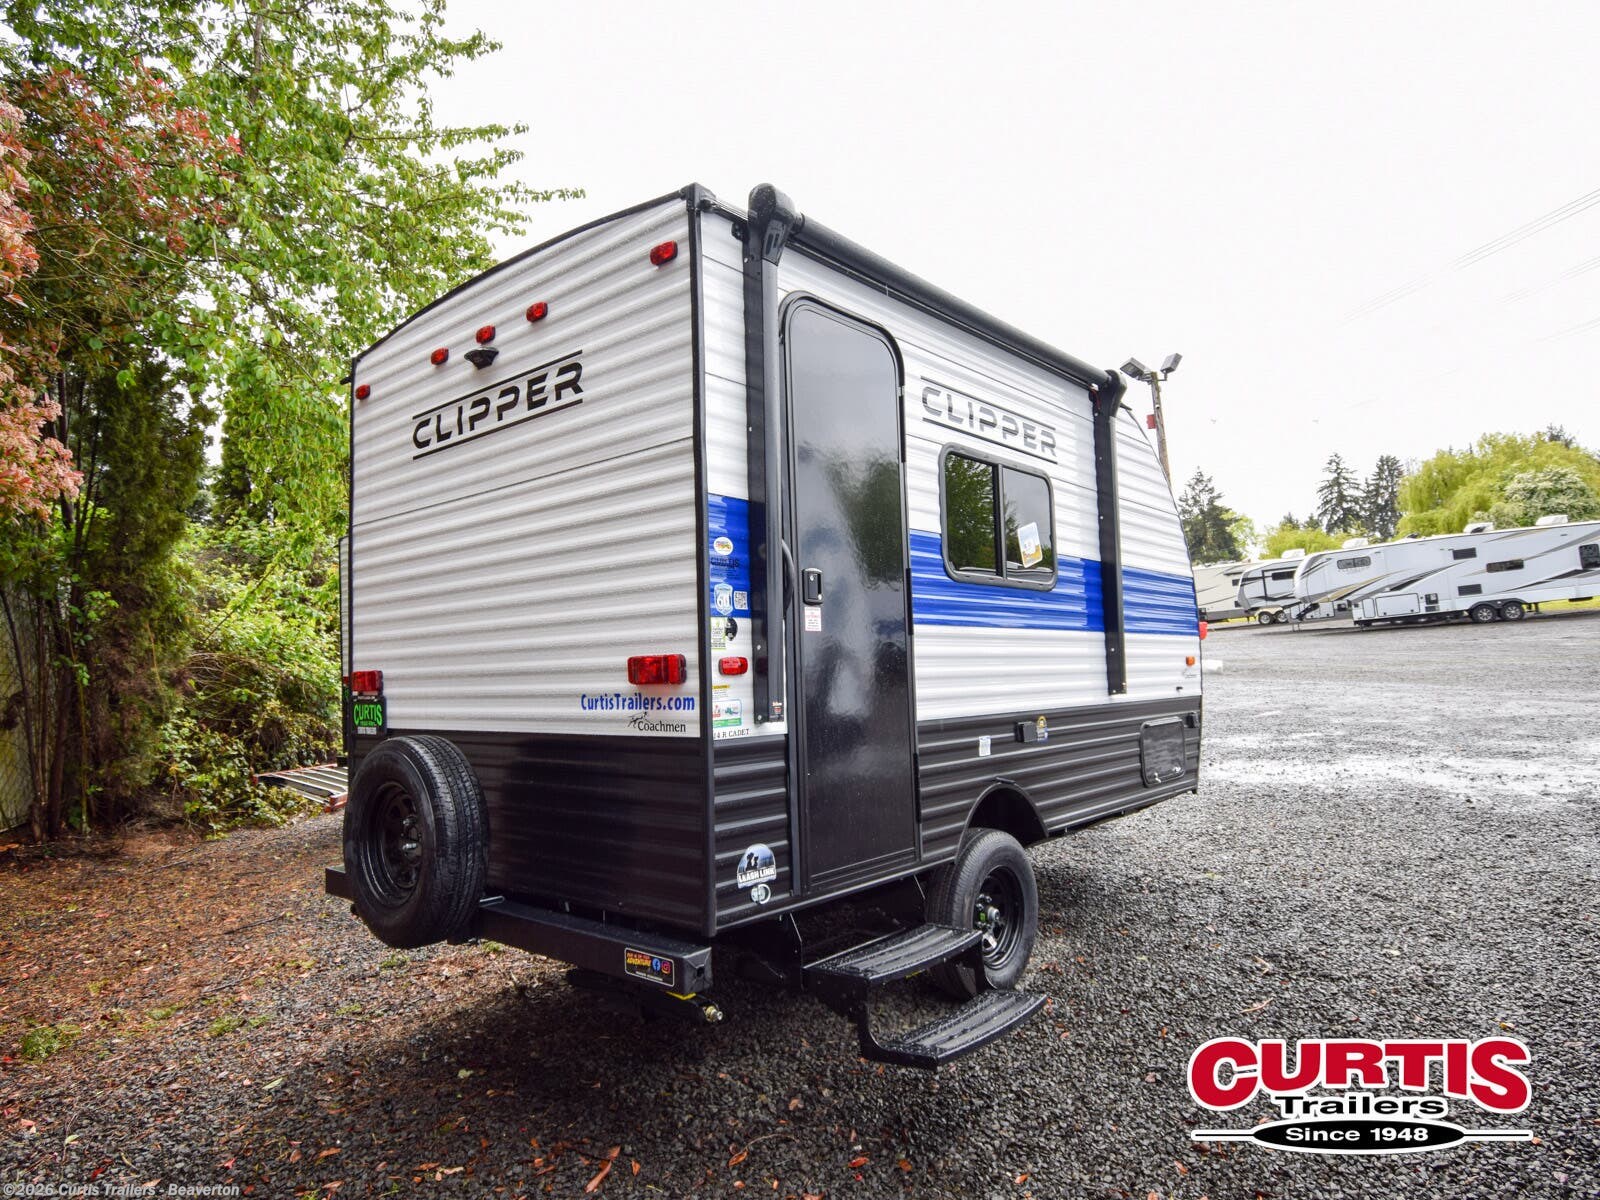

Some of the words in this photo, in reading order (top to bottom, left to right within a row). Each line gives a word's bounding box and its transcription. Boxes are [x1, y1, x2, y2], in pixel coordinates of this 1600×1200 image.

[413, 362, 583, 449] CLIPPER
[922, 386, 1057, 457] CLIPPER
[581, 692, 695, 711] CurtisTrailers.com
[353, 703, 383, 726] CURTIS
[637, 720, 686, 732] Coachmen
[728, 728, 749, 737] CADET
